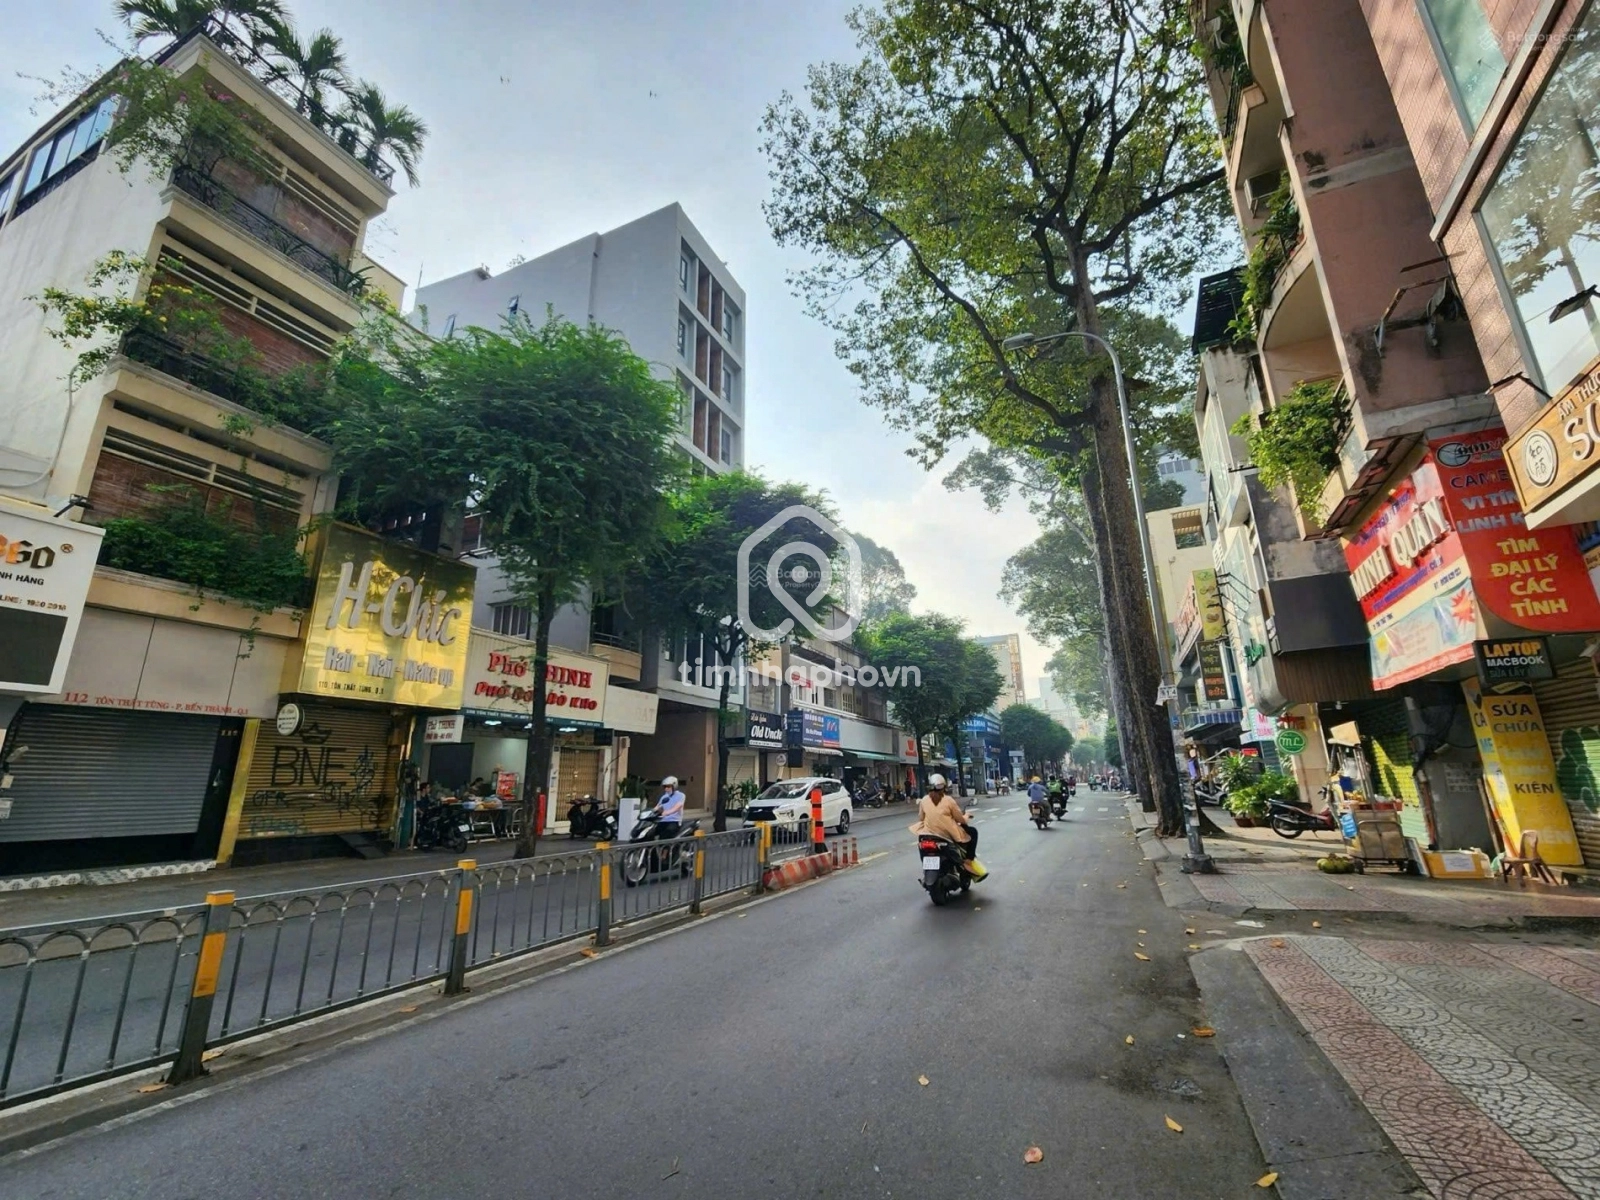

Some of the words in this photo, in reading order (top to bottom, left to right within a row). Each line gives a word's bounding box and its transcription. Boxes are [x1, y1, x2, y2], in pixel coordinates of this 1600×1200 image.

[1461, 496, 1485, 510] VI
[1485, 489, 1520, 507] TÍN
[1456, 513, 1508, 533] LINH
[1349, 544, 1394, 602] MINH
[1391, 496, 1451, 569] QUÂN
[1496, 537, 1540, 555] TÌM
[1490, 559, 1532, 578] ĐẠI
[1533, 553, 1559, 572] LÝ
[1510, 577, 1557, 596] CÁC
[325, 561, 462, 646] H-Chic
[1483, 641, 1541, 658] LAPTOP
[1486, 655, 1545, 667] MACBOOK
[63, 692, 89, 704] 112
[94, 695, 114, 706] TÔN
[1491, 700, 1533, 717] SỬA
[750, 725, 764, 738] Old
[764, 726, 783, 740] Uncle
[1514, 781, 1555, 797] KIỆN
